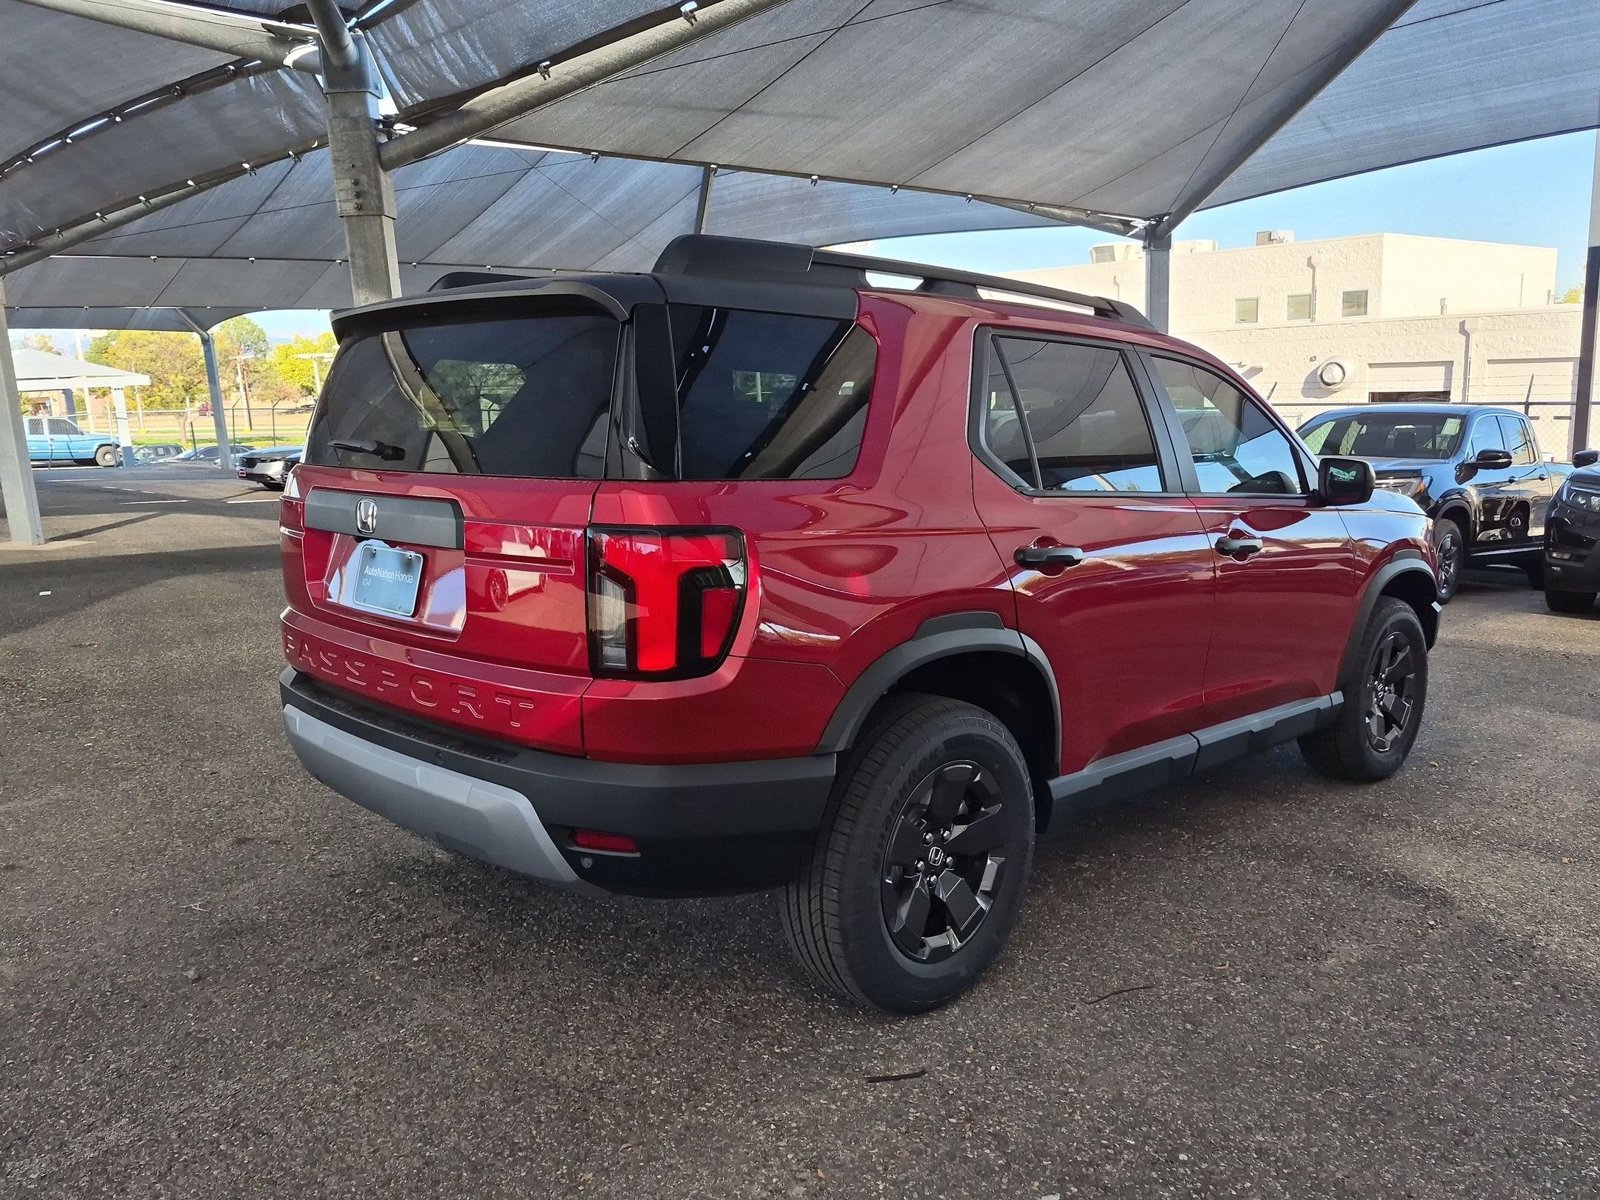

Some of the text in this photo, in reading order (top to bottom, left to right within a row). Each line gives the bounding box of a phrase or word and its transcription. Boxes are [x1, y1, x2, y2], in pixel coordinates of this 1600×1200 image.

[363, 564, 414, 584] AutoNation Honda
[284, 631, 534, 727] PASSPORT
